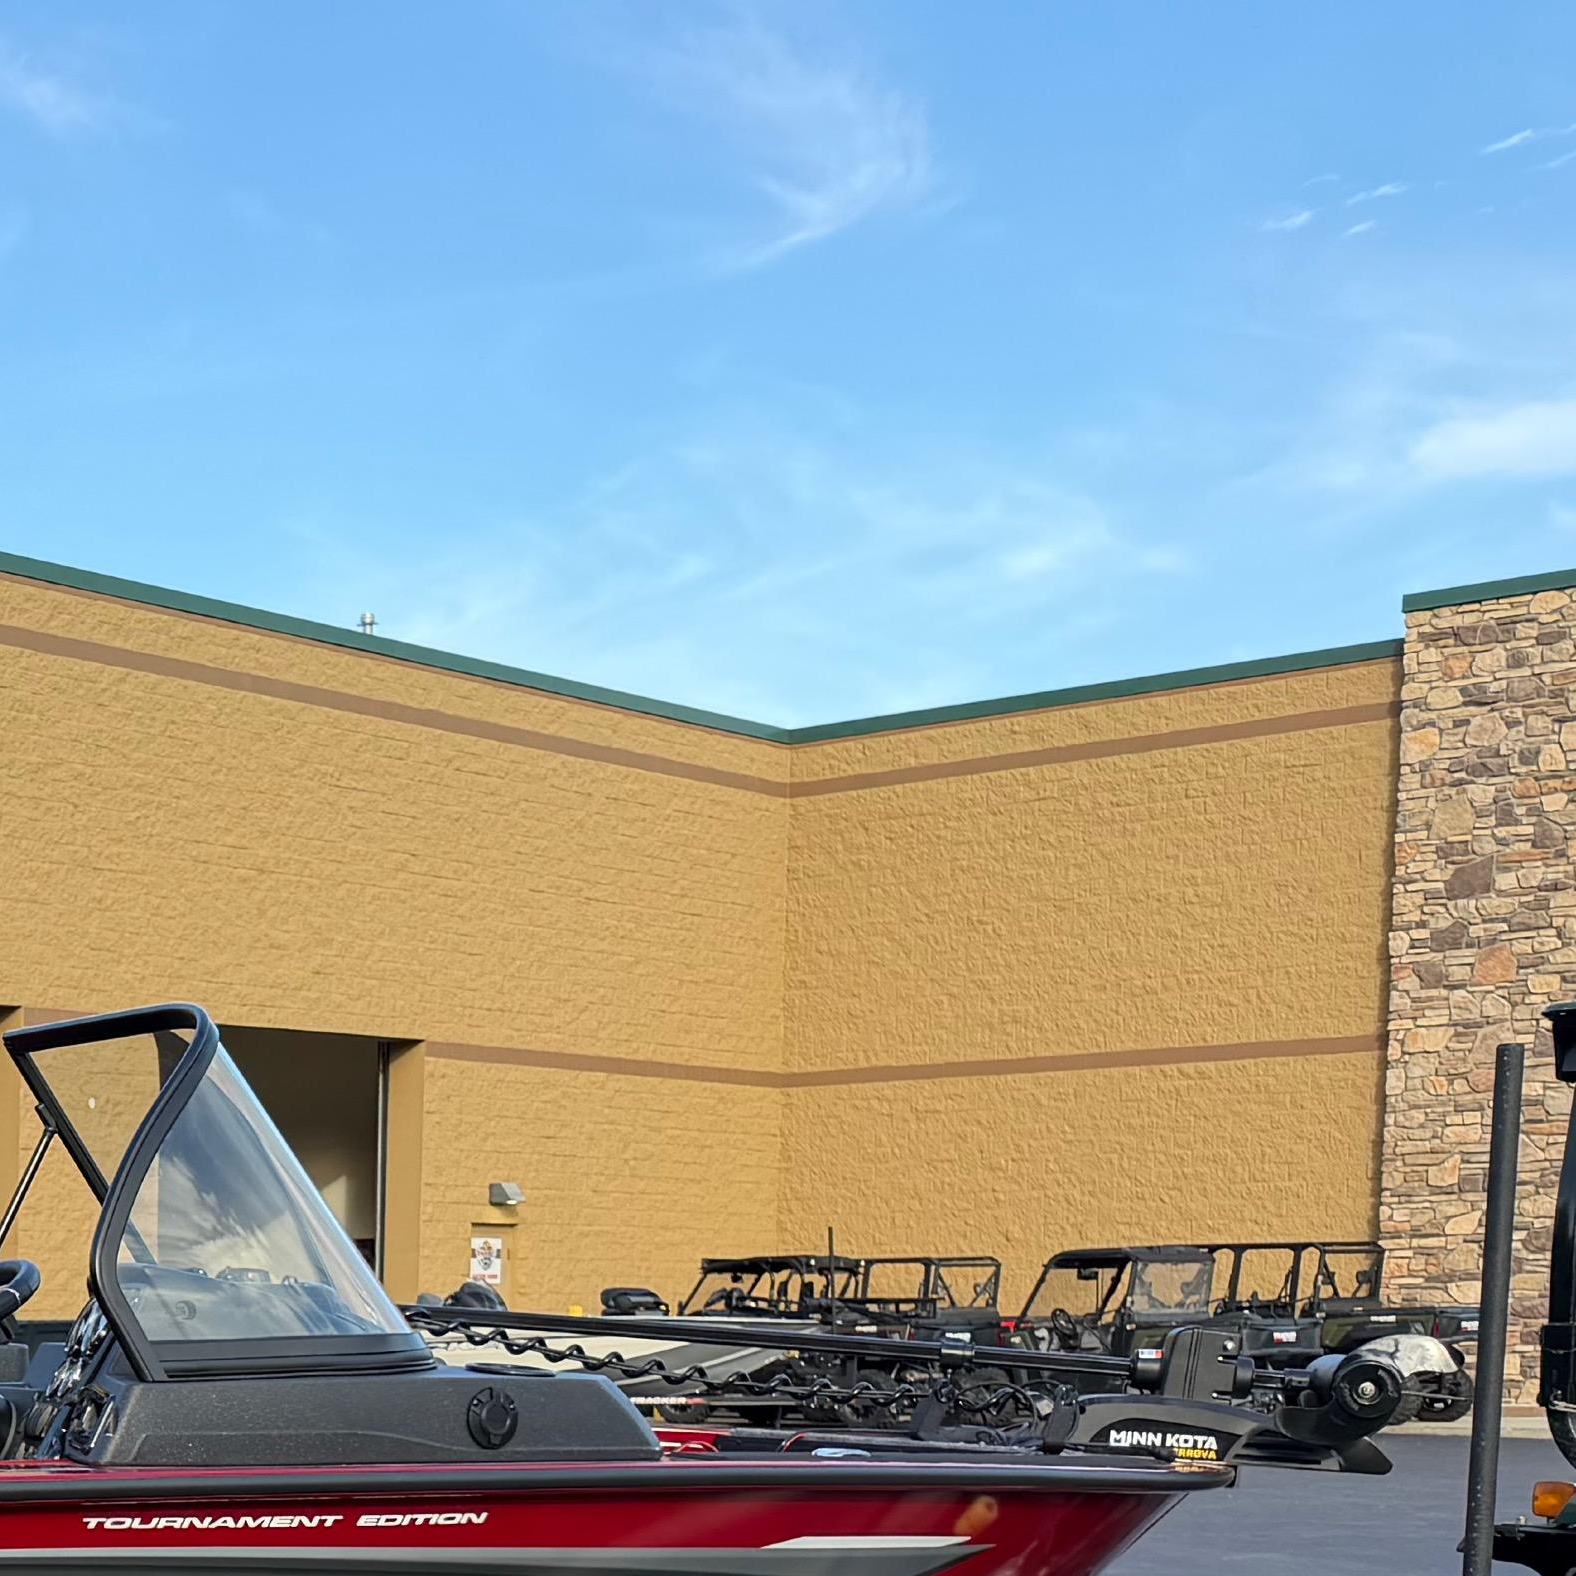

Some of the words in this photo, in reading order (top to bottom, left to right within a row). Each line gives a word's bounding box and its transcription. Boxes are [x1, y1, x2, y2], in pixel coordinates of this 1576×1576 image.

[1110, 1429, 1162, 1447] MINN
[1166, 1433, 1218, 1450] KOTA
[82, 1514, 344, 1530] TOURNAMENT
[356, 1511, 488, 1528] EDITION
